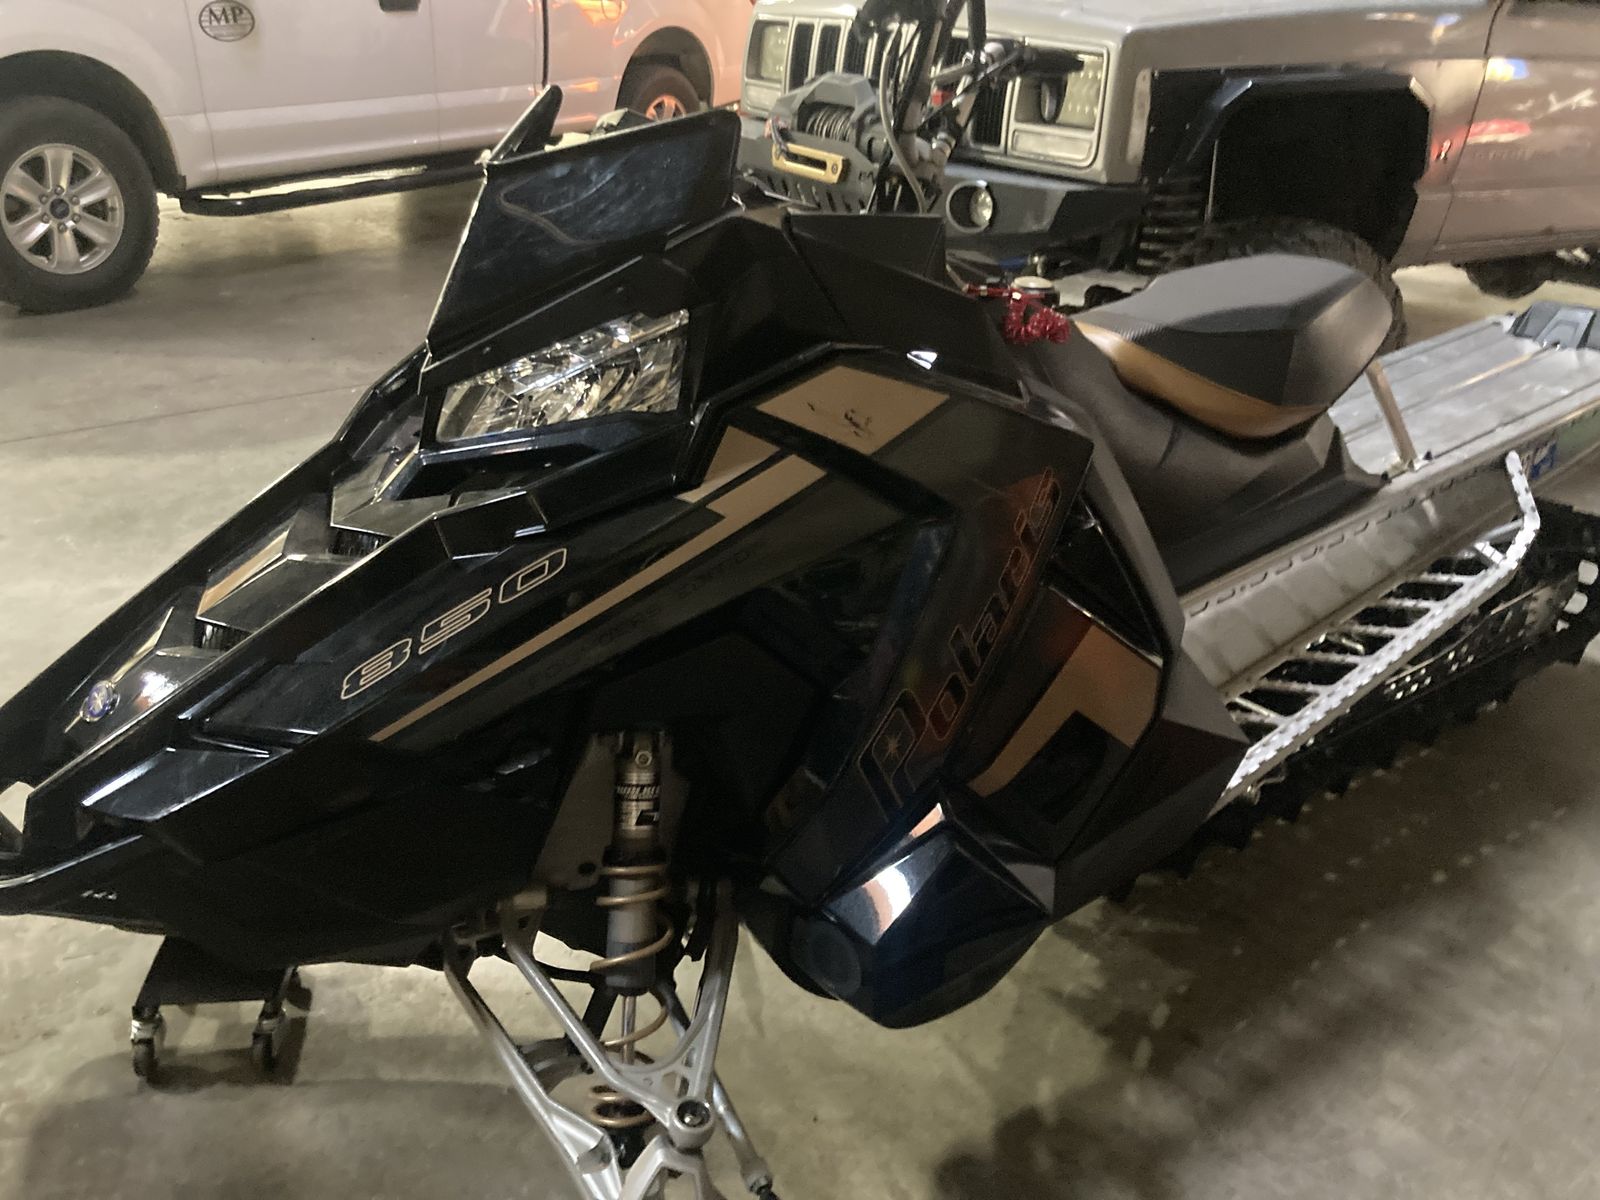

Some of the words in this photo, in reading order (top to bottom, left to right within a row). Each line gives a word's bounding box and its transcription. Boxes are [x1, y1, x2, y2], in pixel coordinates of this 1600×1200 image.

[208, 7, 244, 25] MP
[340, 548, 568, 701] 850
[856, 467, 1062, 824] Polaris
